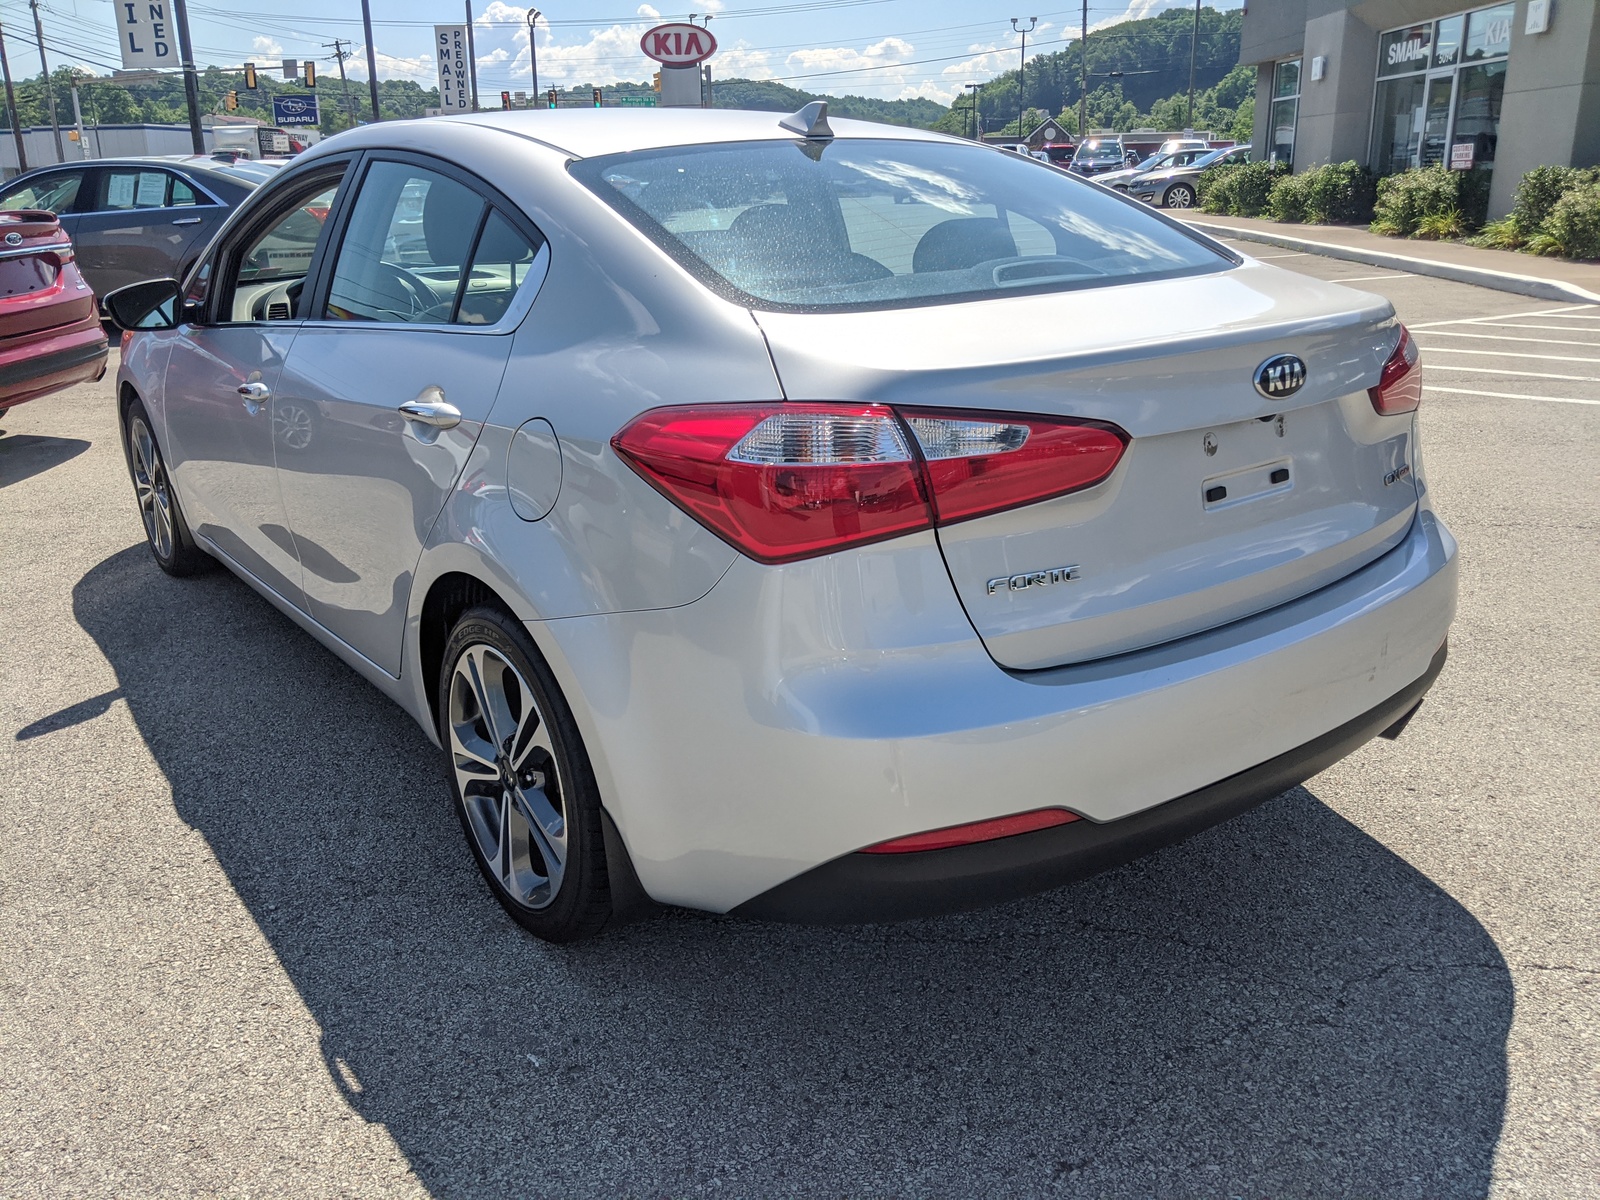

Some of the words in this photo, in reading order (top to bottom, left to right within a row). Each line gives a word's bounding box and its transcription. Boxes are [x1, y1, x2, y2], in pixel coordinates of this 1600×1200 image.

[653, 33, 704, 55] KIA
[1485, 20, 1510, 46] KIA
[1387, 38, 1424, 65] SMAIL
[440, 33, 453, 106] SMAIL
[453, 30, 467, 109] PREOWNED
[1267, 362, 1304, 392] KIA
[987, 564, 1082, 595] FORTE
[458, 625, 481, 639] EDGE
